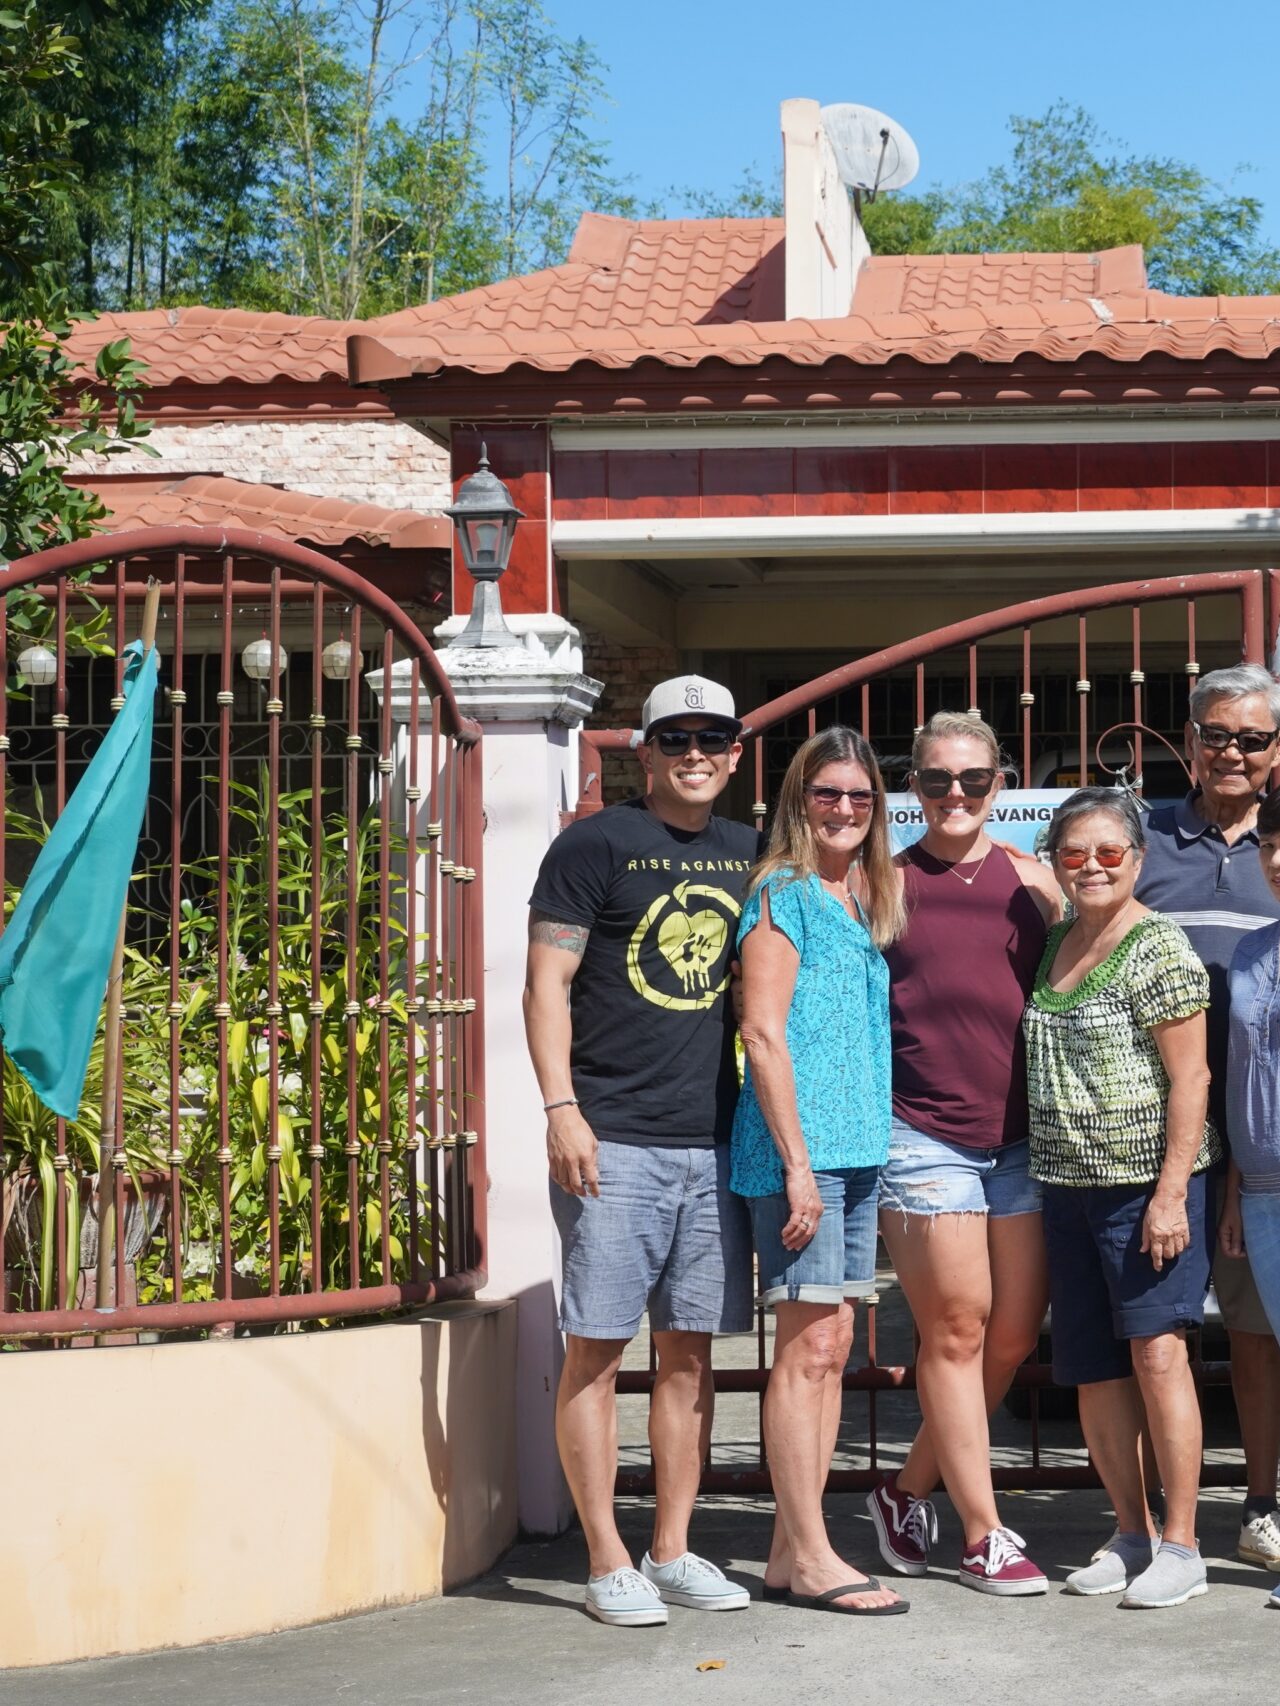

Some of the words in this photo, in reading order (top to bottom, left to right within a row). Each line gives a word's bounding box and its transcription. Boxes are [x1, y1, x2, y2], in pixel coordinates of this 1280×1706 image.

[888, 810, 927, 824] JOH
[986, 807, 1057, 822] EVANG
[627, 859, 672, 871] RISE
[681, 860, 751, 871] AGAINST
